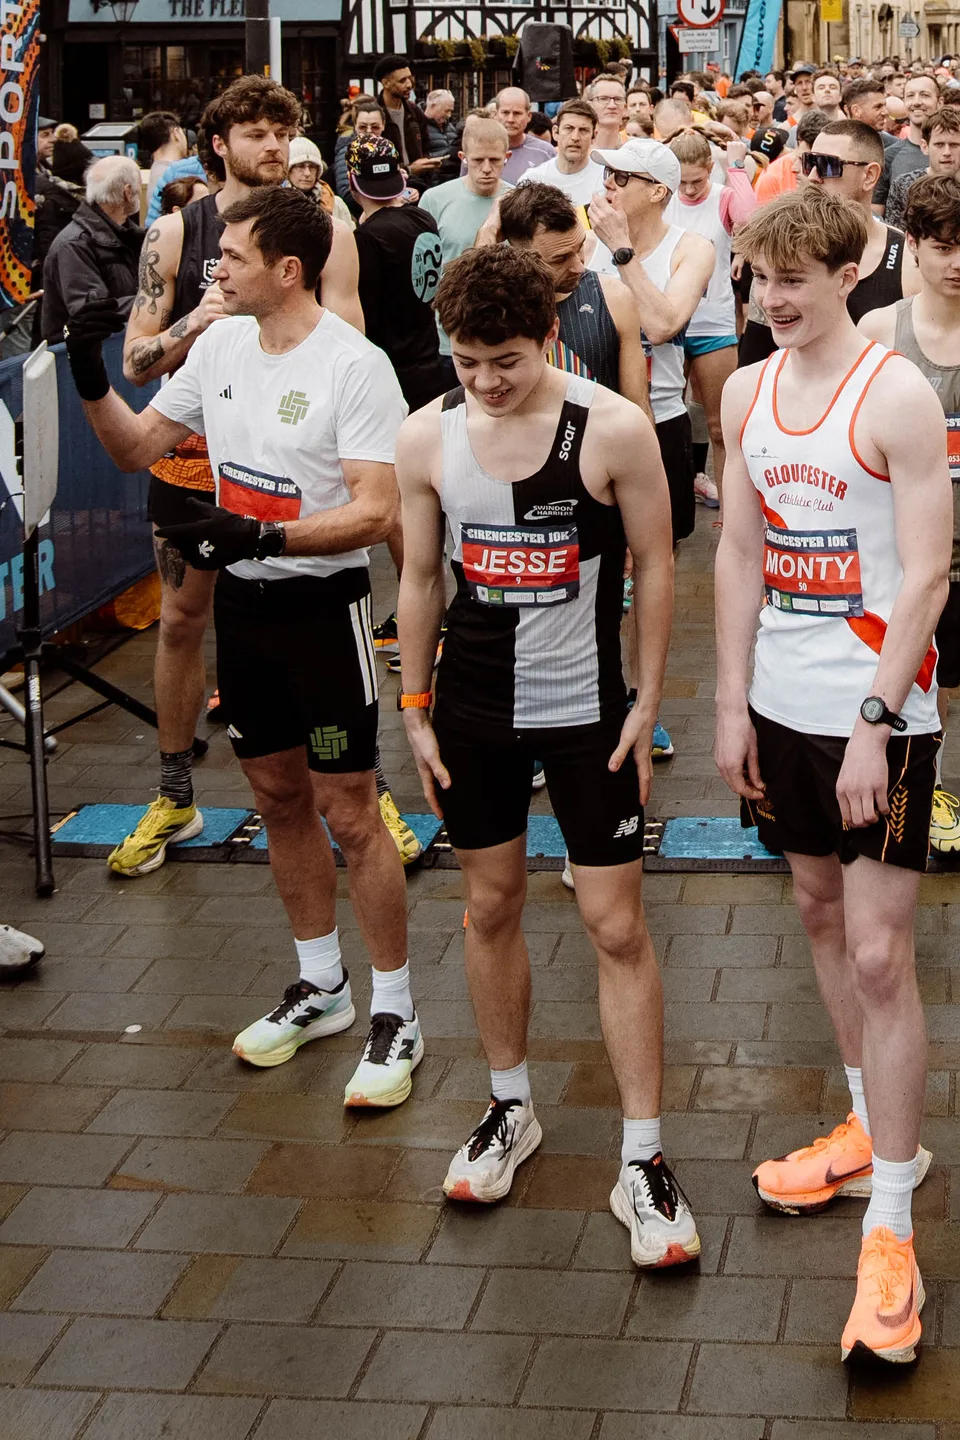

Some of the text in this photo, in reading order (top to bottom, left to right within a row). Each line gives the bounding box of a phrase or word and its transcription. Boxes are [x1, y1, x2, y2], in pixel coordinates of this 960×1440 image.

[208, 0, 247, 17] FLE
[559, 421, 576, 461] soar
[222, 464, 297, 494] CIRENCESTER 10K
[764, 463, 848, 500] GLOUCESTER
[779, 493, 834, 512] Athletic Club
[467, 528, 569, 543] CIRENCESTER 10K
[766, 529, 849, 547] CIRENCESTER 10K
[473, 549, 567, 574] JESSE
[765, 549, 854, 580] MONTY
[516, 576, 521, 585] 9
[798, 582, 807, 591] 50
